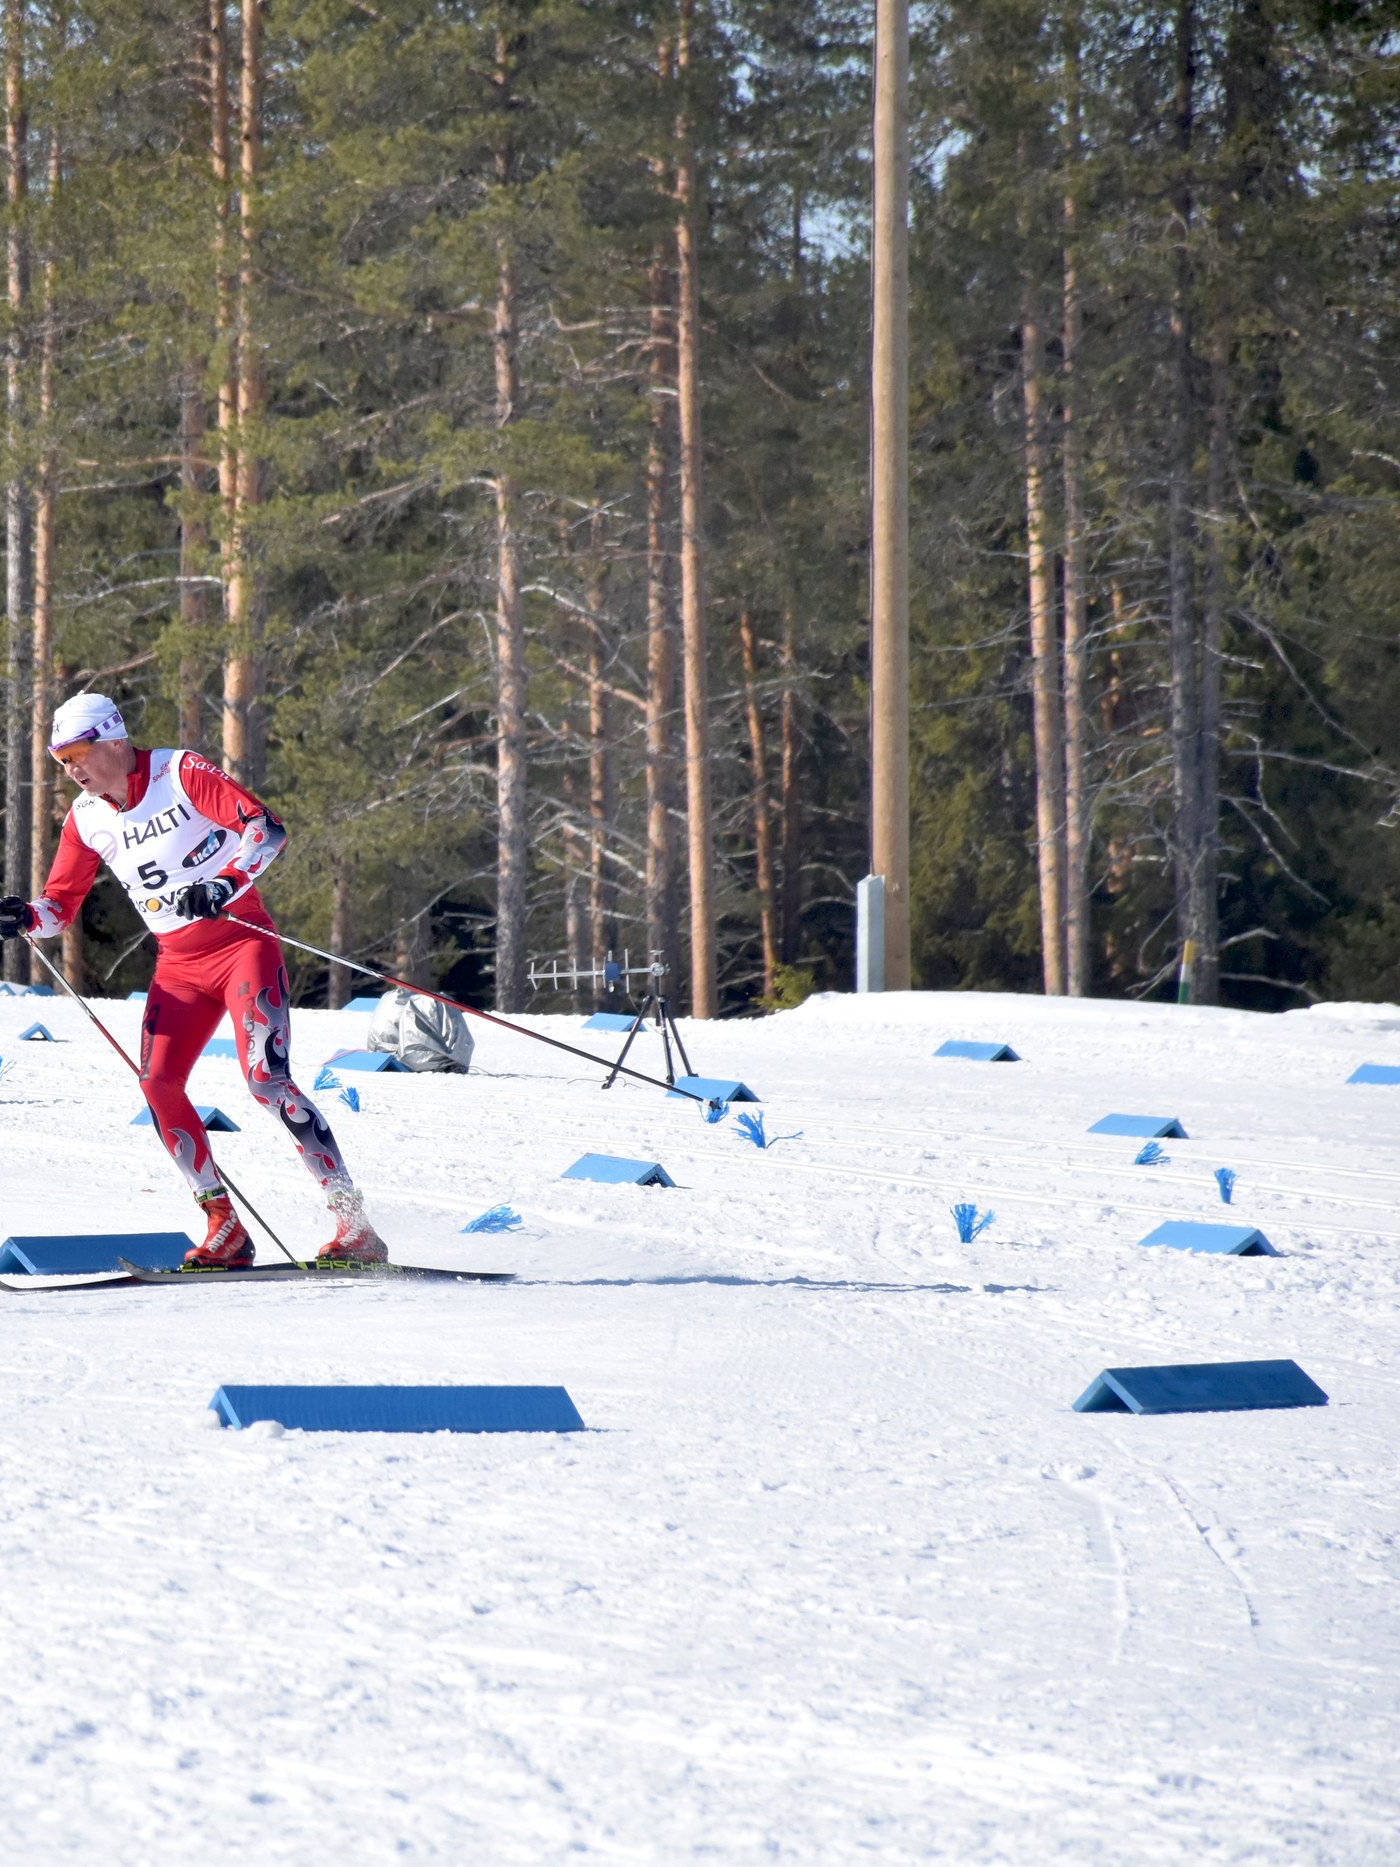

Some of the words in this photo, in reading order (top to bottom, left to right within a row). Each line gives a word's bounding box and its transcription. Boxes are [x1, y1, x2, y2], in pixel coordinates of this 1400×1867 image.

[123, 803, 191, 849] HALTI
[137, 860, 169, 890] 5
[206, 1209, 239, 1253] alpina
